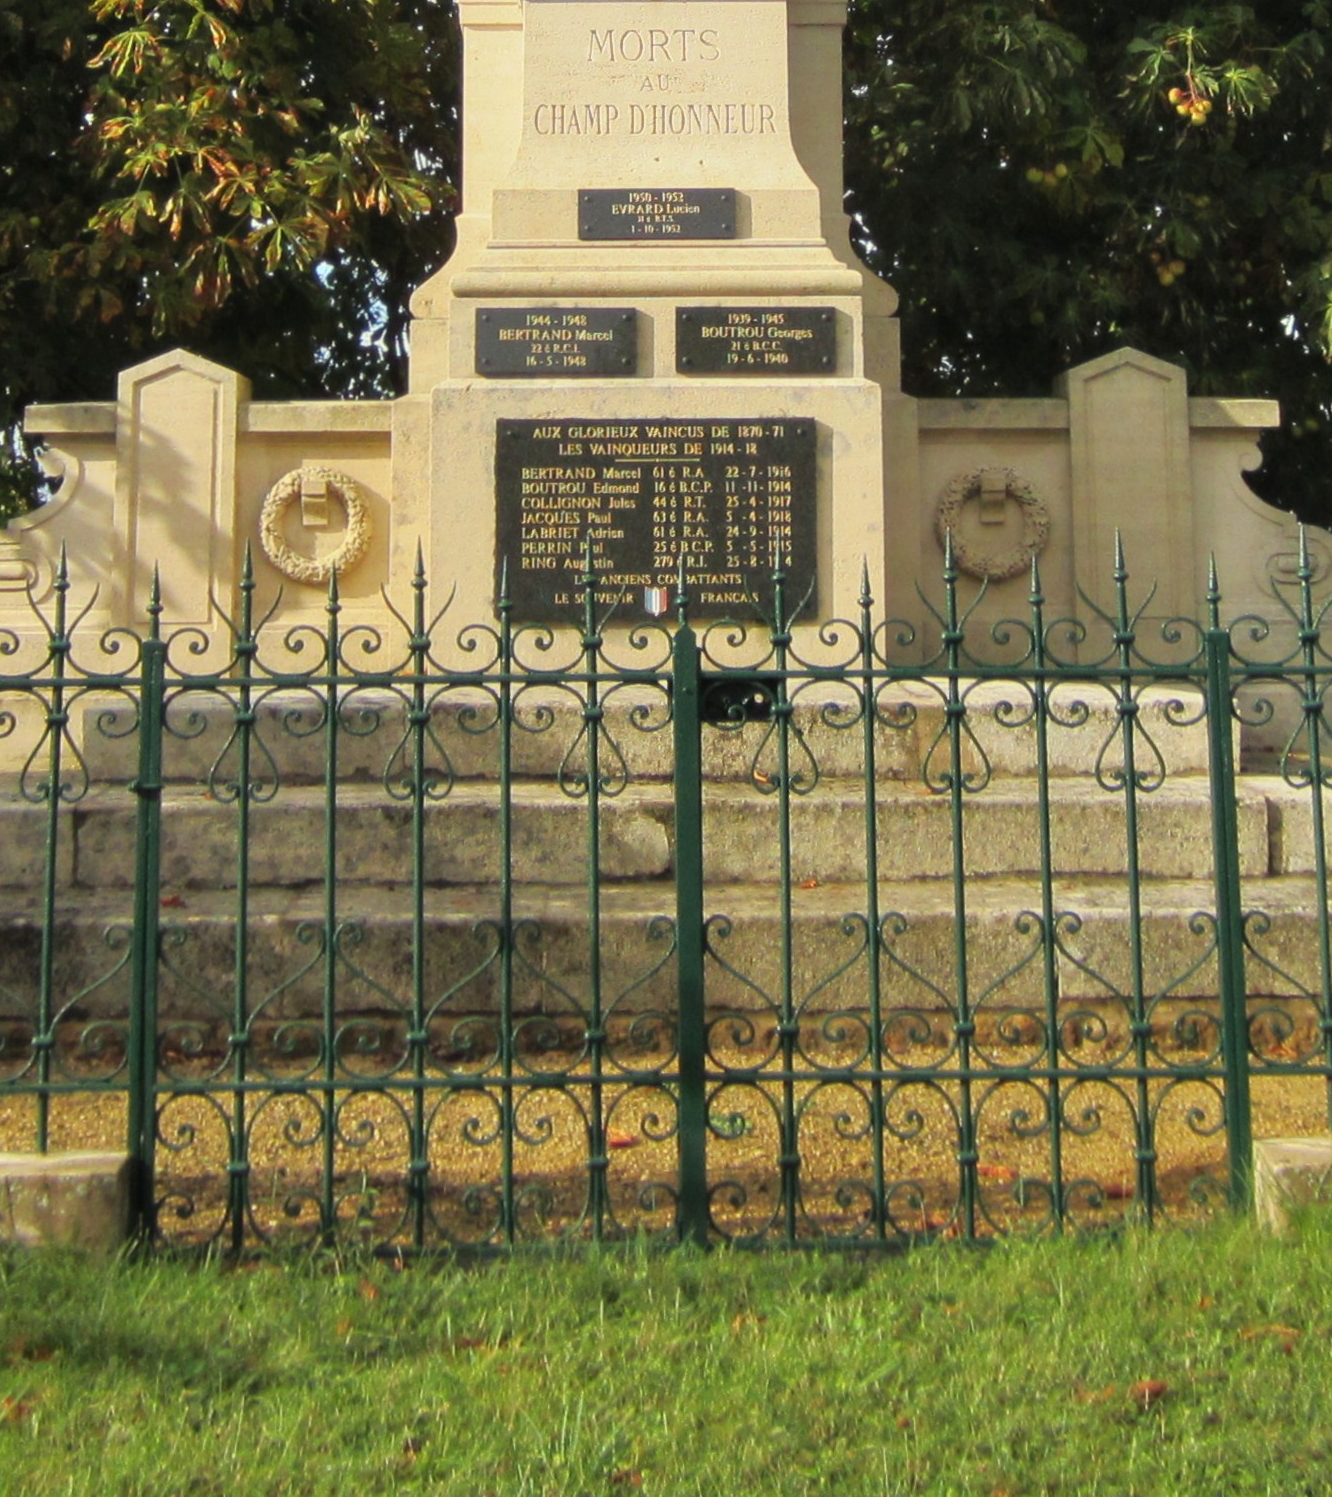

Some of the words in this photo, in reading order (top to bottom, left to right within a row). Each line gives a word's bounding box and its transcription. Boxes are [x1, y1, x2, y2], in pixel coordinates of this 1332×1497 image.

[587, 29, 719, 62] MORTS
[640, 74, 670, 91] AU
[534, 104, 618, 135] CHAMP
[629, 104, 775, 135] D'HONNEUR
[629, 192, 652, 202] 1950
[612, 204, 663, 214] EVRARD
[667, 204, 700, 214] Lucien
[662, 225, 681, 233] 1952
[526, 315, 550, 325] 1944
[563, 315, 587, 325] 1948
[728, 314, 751, 324] 1939
[762, 314, 784, 324] 1945
[499, 330, 572, 340] BERTRAND
[576, 330, 613, 341] Marcel
[702, 327, 764, 338] BOUTROU
[768, 327, 813, 340] Georges
[531, 344, 542, 353] 22
[526, 356, 537, 366] 16
[546, 356, 552, 366] 5
[564, 356, 586, 366] 1948
[727, 354, 738, 364] 19
[747, 354, 754, 364] 6
[765, 354, 788, 364] 1940
[533, 427, 561, 439] AUX
[569, 426, 638, 438] GLORIEUX
[646, 426, 704, 438] VAINCUS
[711, 426, 729, 438] DE
[559, 444, 583, 455] LES
[590, 443, 676, 456] VAINQUEURS
[684, 443, 702, 455] DE
[711, 443, 734, 454] 1914
[522, 468, 596, 479] BERTRAND
[603, 467, 641, 479] Marcel
[653, 467, 664, 478] 61
[725, 466, 739, 478] 22
[768, 466, 791, 477] 1916
[522, 482, 586, 494] BOUTROU
[593, 482, 640, 494] Edmond
[655, 481, 666, 493] 16
[768, 481, 791, 492] 1914
[522, 497, 601, 509] COLLIGNON
[609, 497, 636, 509] Jules
[653, 496, 666, 508] 44
[726, 496, 739, 507] 25
[768, 496, 791, 507] 1917
[588, 513, 611, 523] Paul
[726, 511, 733, 522] 5
[768, 511, 791, 522] 1918
[522, 527, 579, 539] LABRIET
[653, 526, 665, 537] 61
[726, 526, 739, 537] 24
[522, 542, 571, 554] PERRIN
[580, 542, 603, 554] Pul
[654, 541, 667, 552] 25
[726, 540, 733, 552] 5
[522, 557, 556, 569] RING
[564, 557, 613, 571] Augstin
[654, 556, 673, 567] 279
[727, 555, 740, 567] 25
[768, 555, 792, 566] 14
[600, 575, 651, 585] ANCIENS
[555, 593, 568, 603] LE
